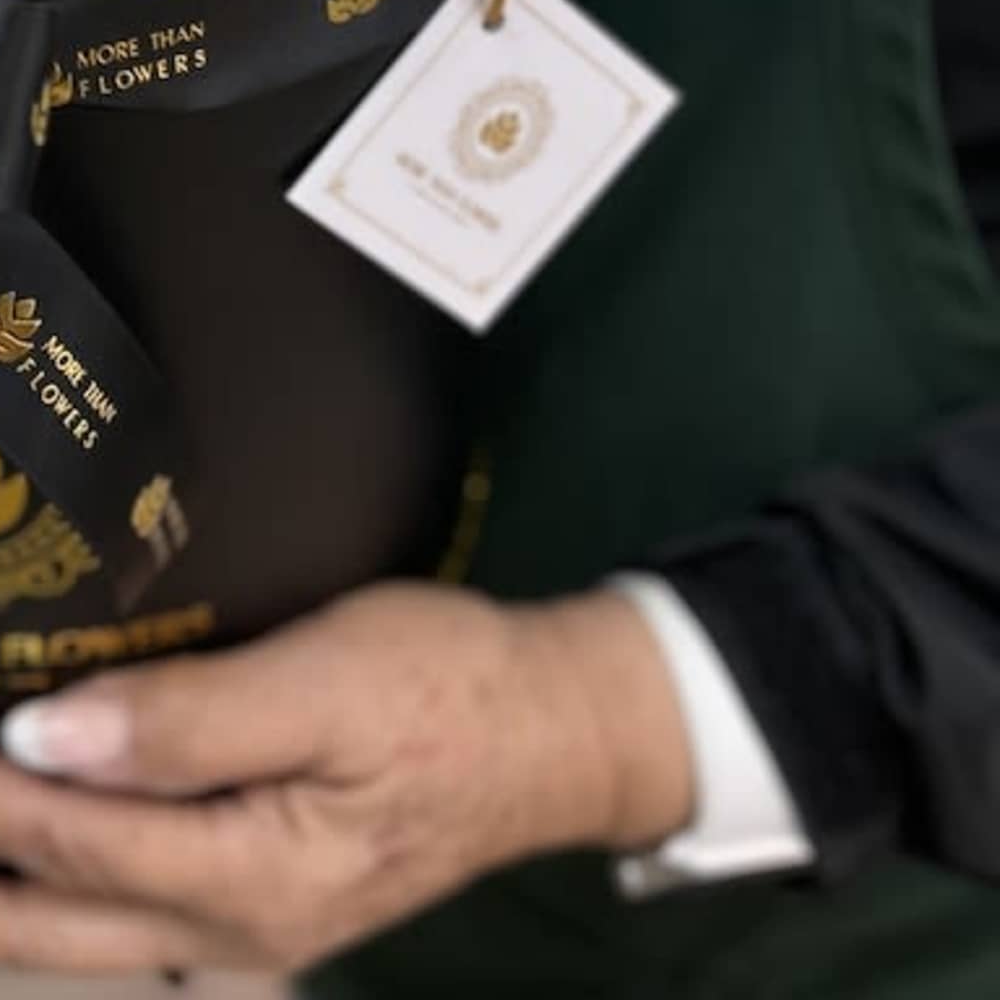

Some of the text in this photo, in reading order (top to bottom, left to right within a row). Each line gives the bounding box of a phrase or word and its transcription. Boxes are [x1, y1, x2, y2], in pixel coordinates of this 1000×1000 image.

[76, 21, 206, 70] MORE THAN
[78, 48, 208, 99] FLOWERS
[15, 356, 99, 450] FLOWERS
[40, 335, 119, 424] MORE THAN
